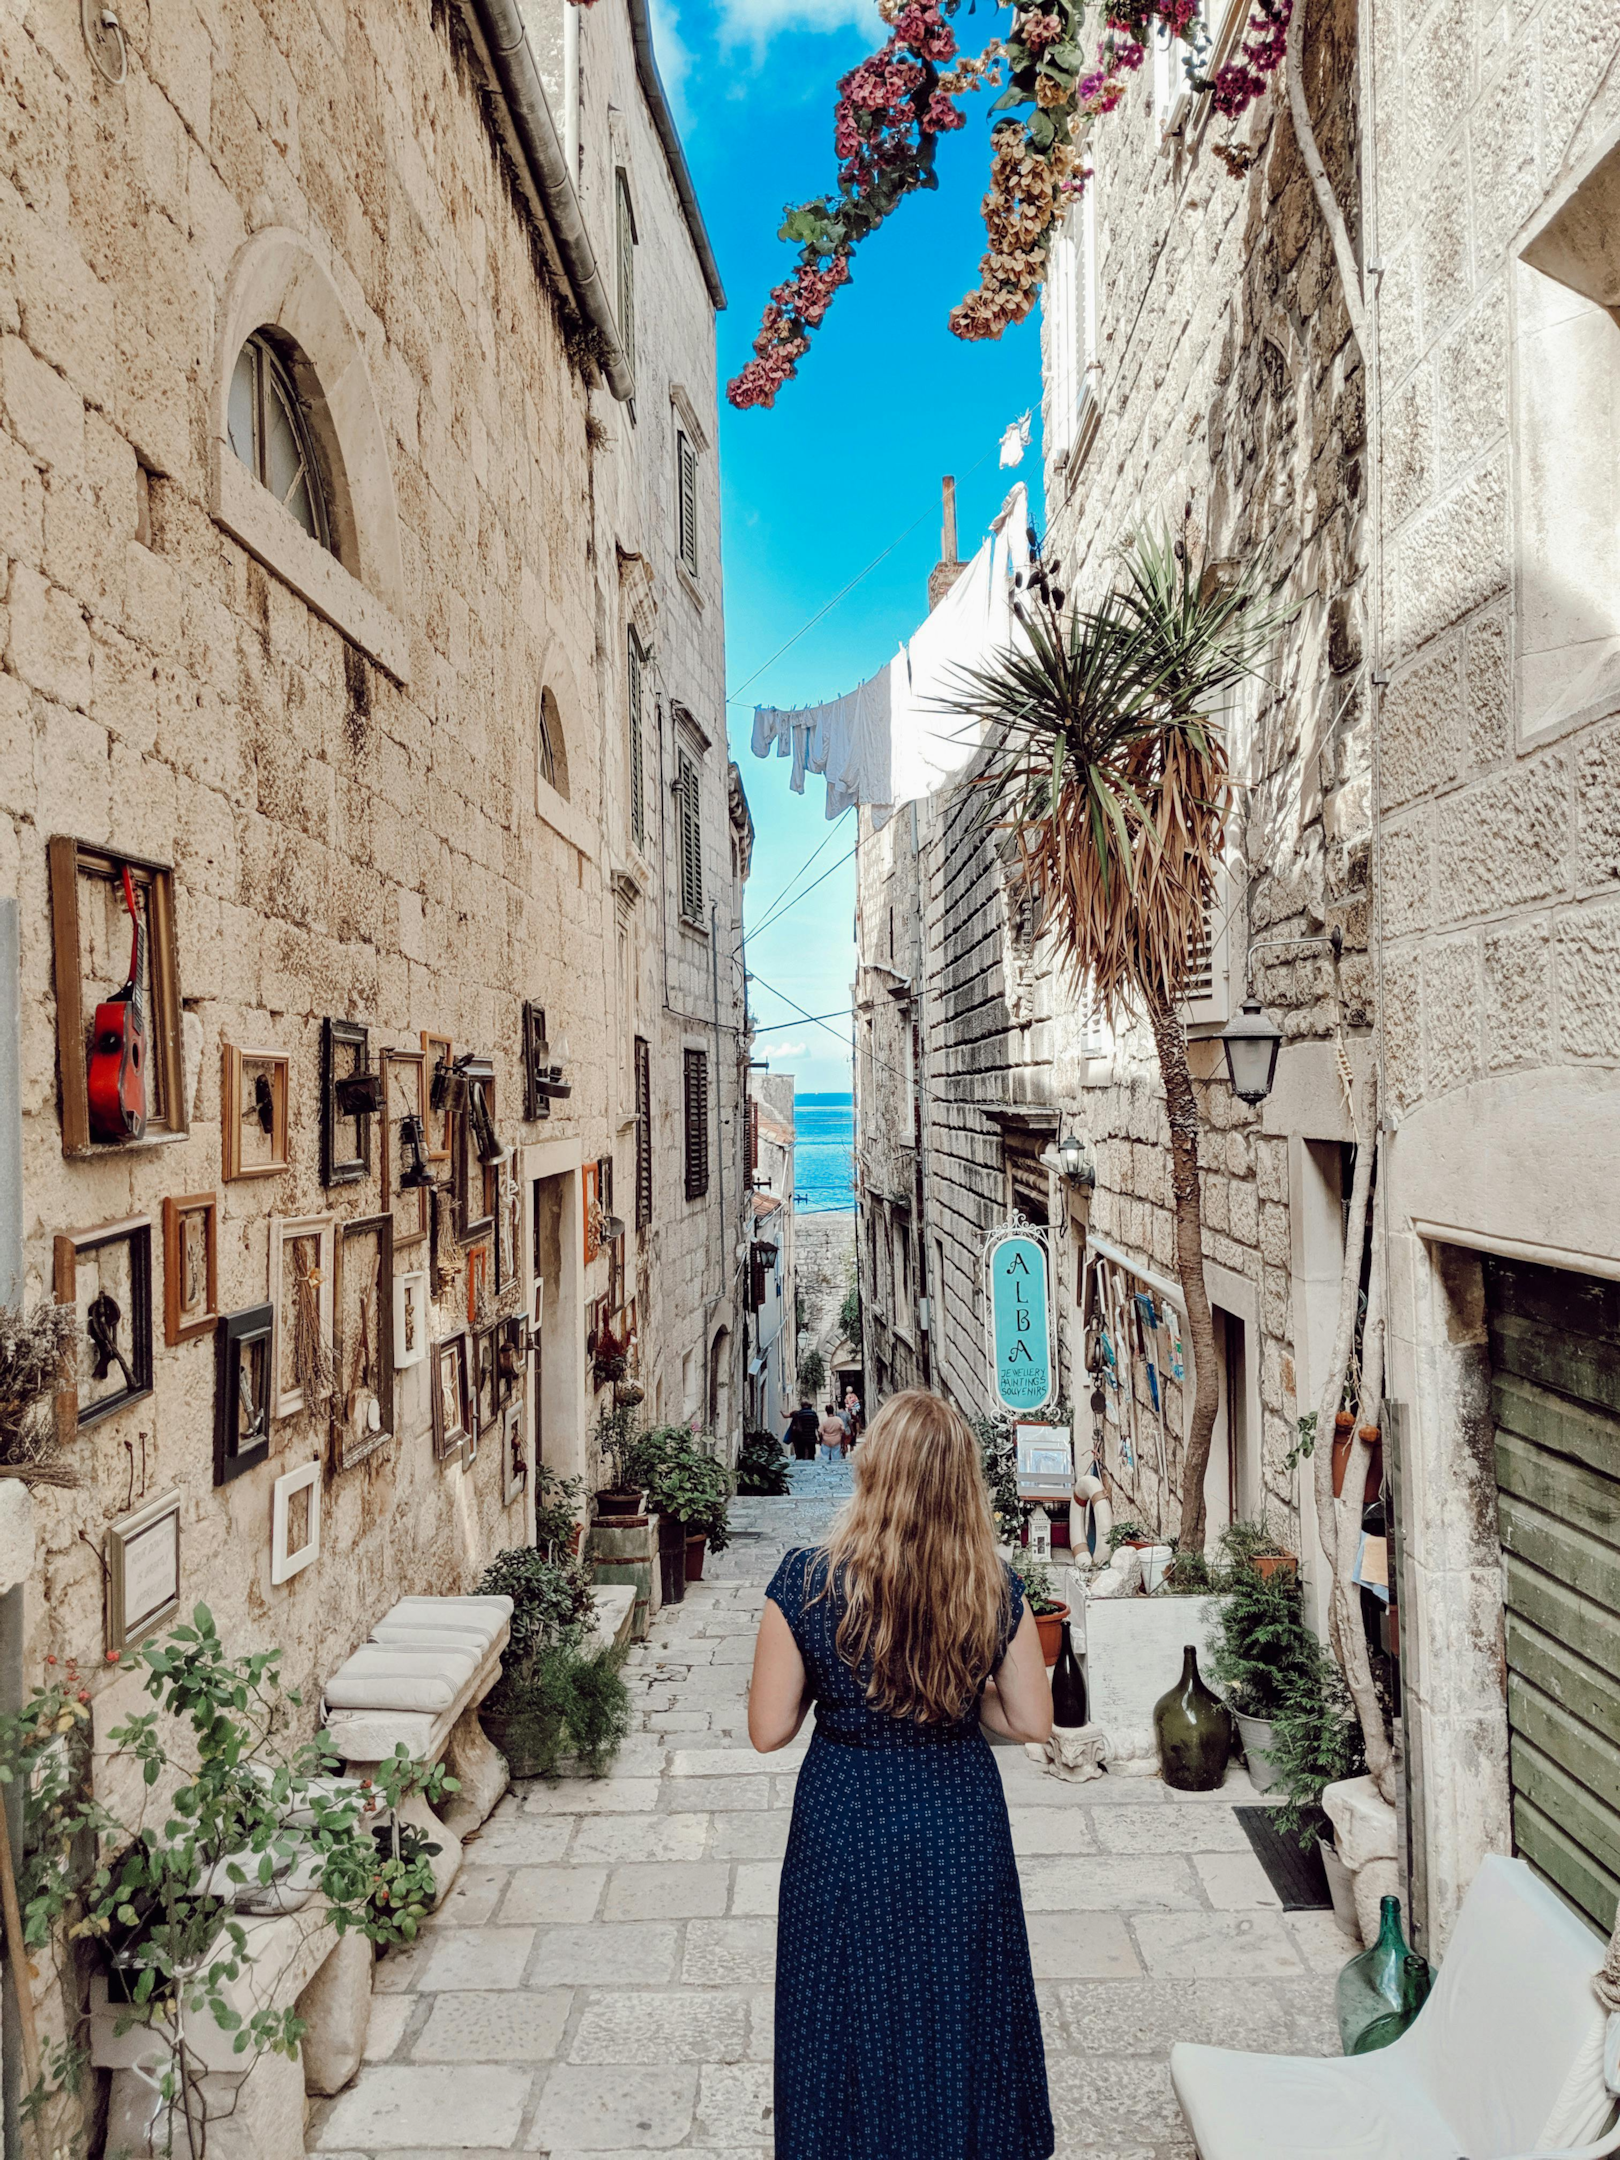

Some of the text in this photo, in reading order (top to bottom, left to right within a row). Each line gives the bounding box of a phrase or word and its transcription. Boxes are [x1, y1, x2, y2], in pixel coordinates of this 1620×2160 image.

[1006, 1253, 1034, 1362] ALBA
[1001, 1368, 1045, 1378] JEWELLERY
[1001, 1376, 1046, 1387] PAINTINGS
[1001, 1386, 1047, 1399] SOUVENIRS
